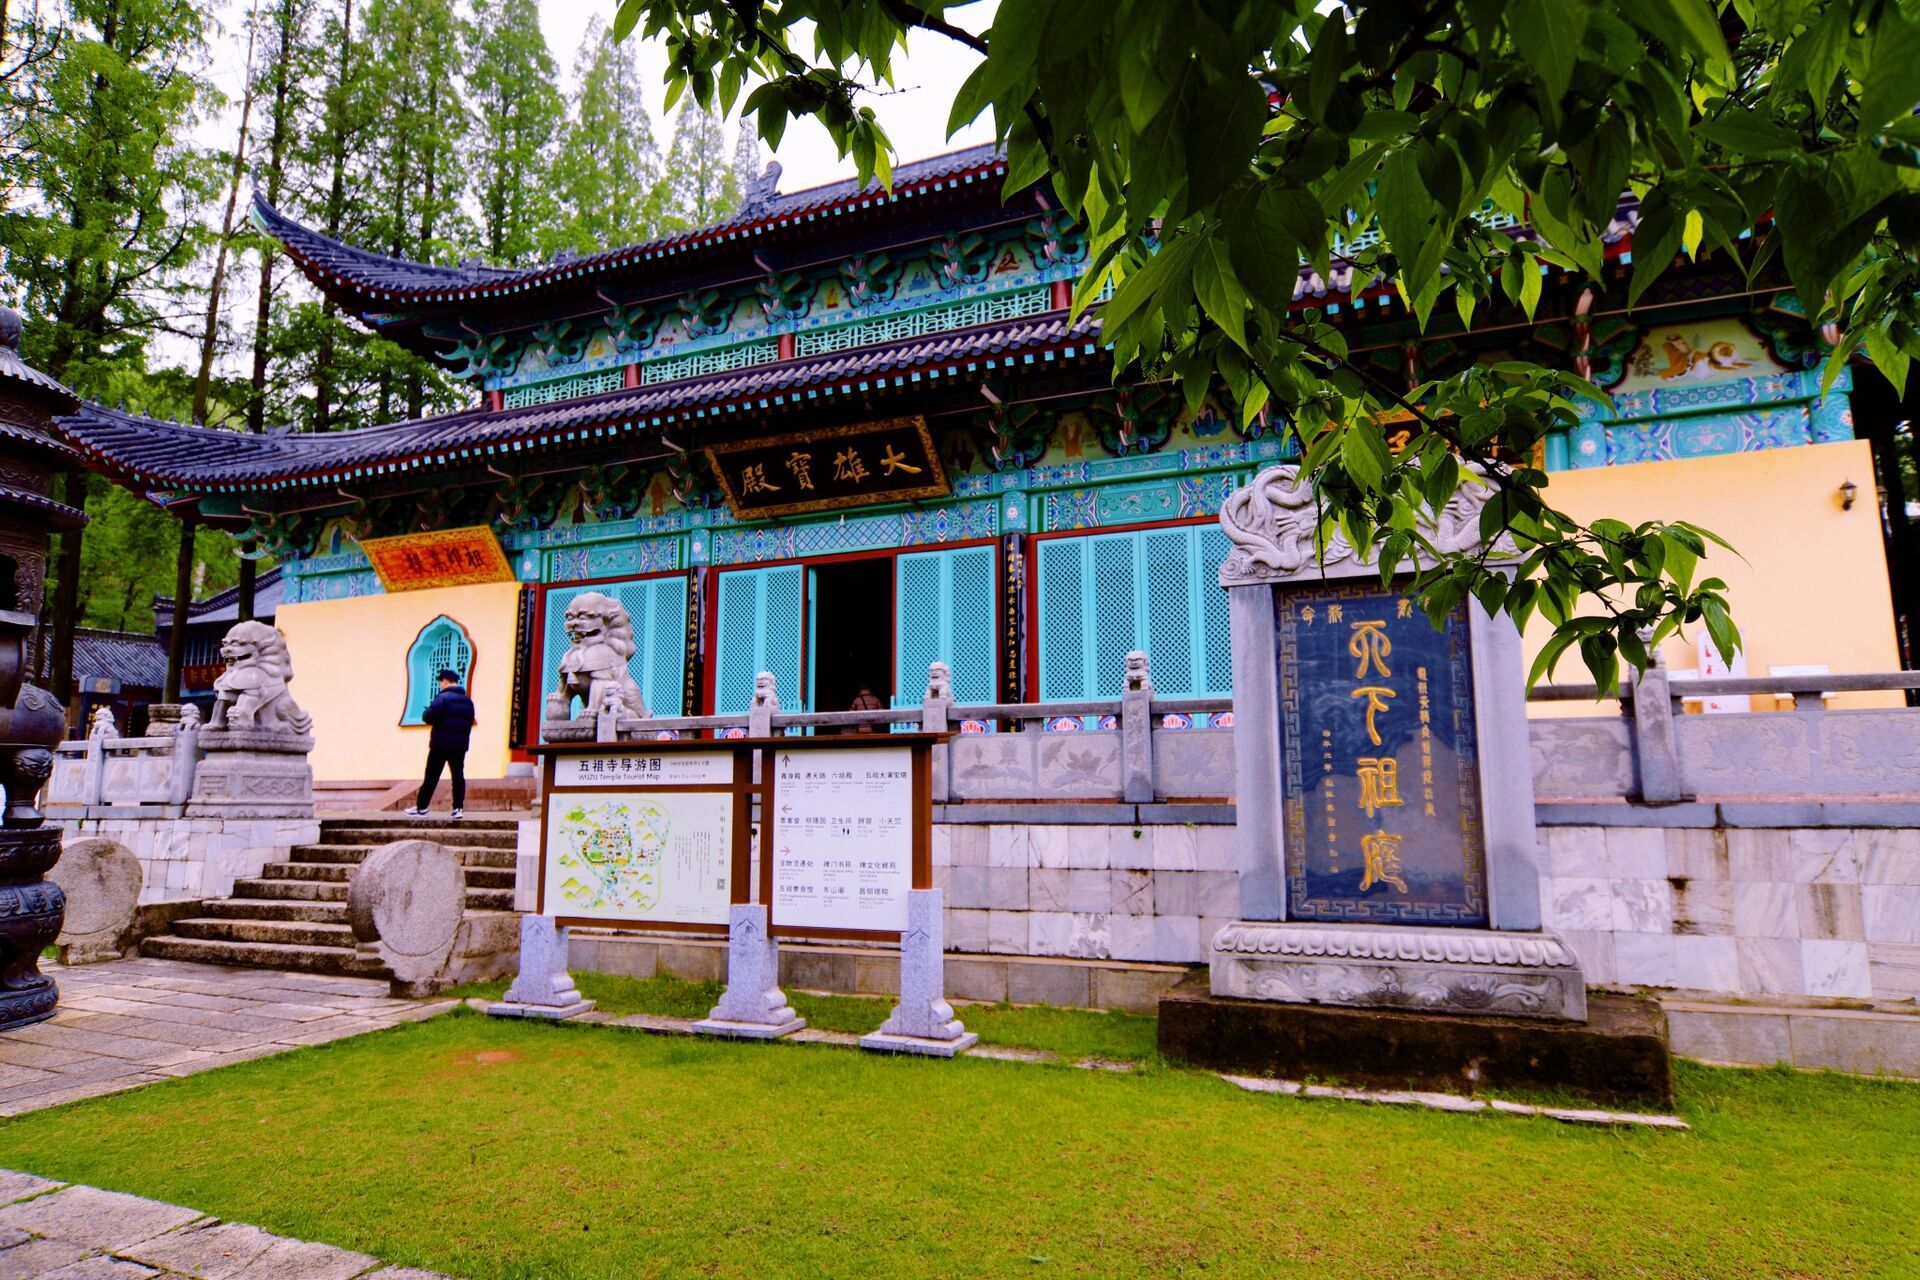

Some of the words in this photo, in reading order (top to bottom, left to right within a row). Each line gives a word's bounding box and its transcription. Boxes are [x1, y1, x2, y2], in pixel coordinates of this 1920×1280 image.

[742, 444, 923, 497] 大雄寶殿
[579, 758, 661, 772] 五祖寺导游图
[646, 773, 660, 781] Map
